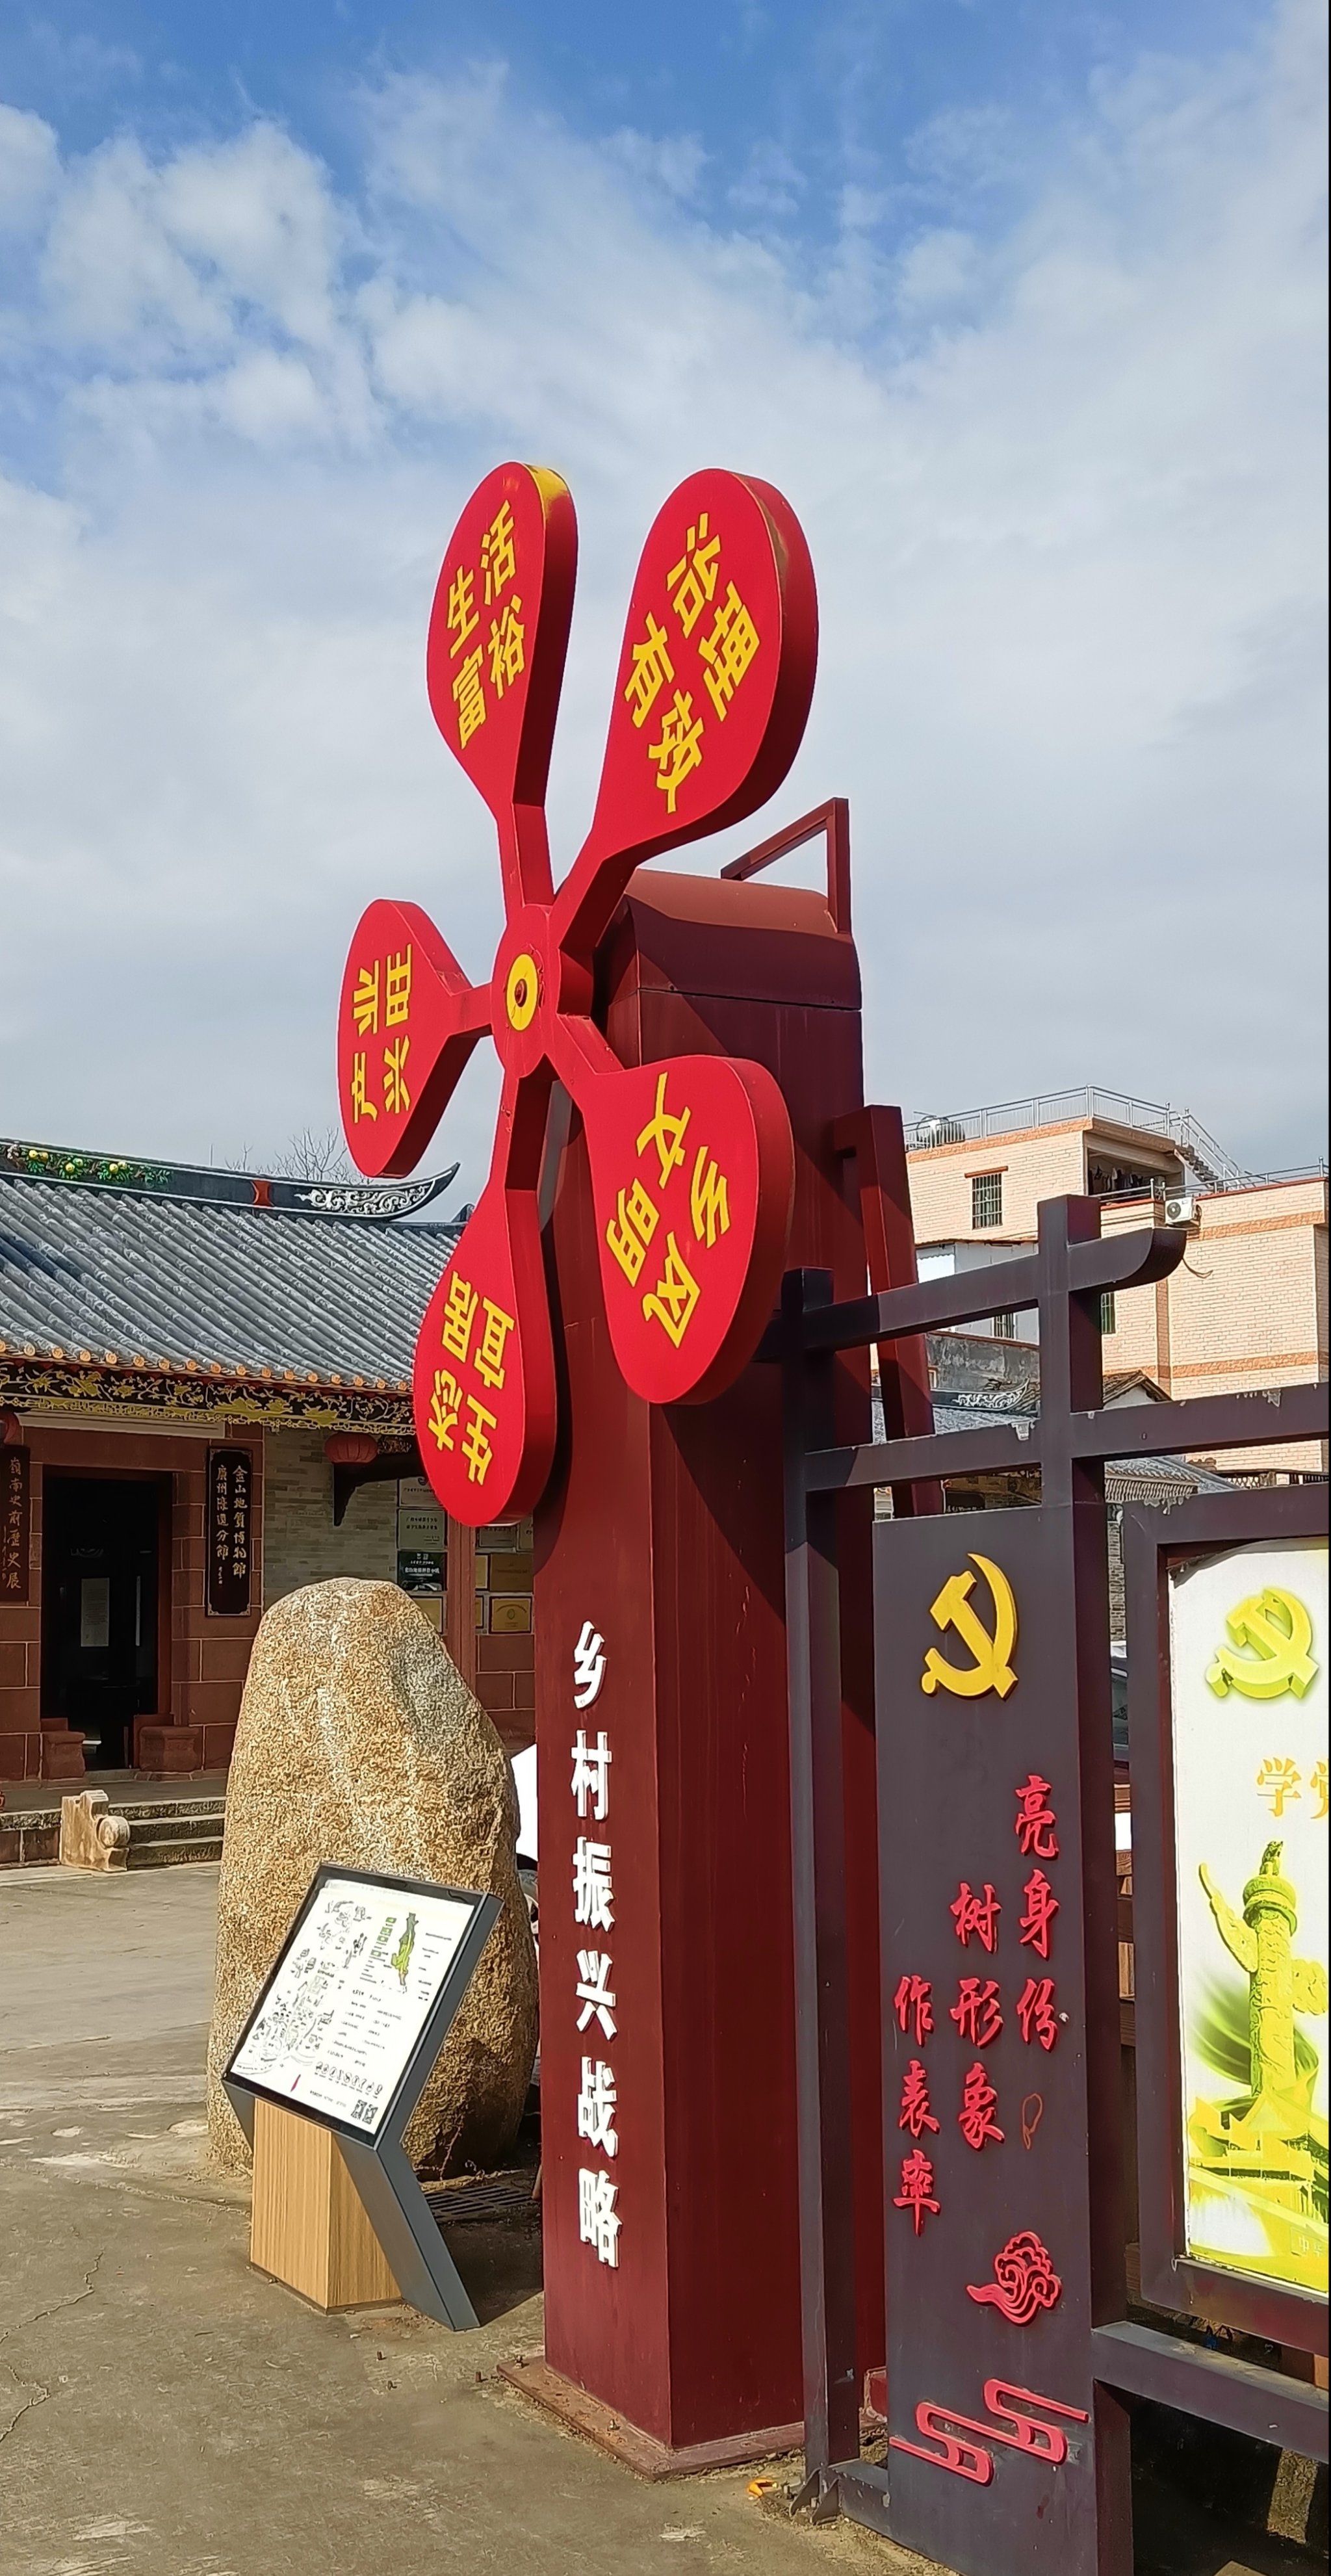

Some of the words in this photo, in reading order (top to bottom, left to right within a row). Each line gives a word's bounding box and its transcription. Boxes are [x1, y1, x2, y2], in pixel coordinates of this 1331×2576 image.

[446, 500, 517, 658] 生活
[451, 594, 524, 749] 富裕
[666, 513, 760, 722] 治理
[623, 612, 704, 813] 有效
[352, 959, 380, 1123] 产业
[384, 944, 413, 1113] 兴旺
[605, 1073, 691, 1287] 文明
[641, 1146, 732, 1349] 乡风
[427, 1369, 496, 1485] 生态
[441, 1271, 515, 1389] 宜居
[570, 1620, 623, 2269] 乡村振兴战略
[1014, 1775, 1059, 2052] 亮身份
[893, 1975, 940, 2236] 作表率
[950, 1882, 1005, 2151] 树形象
